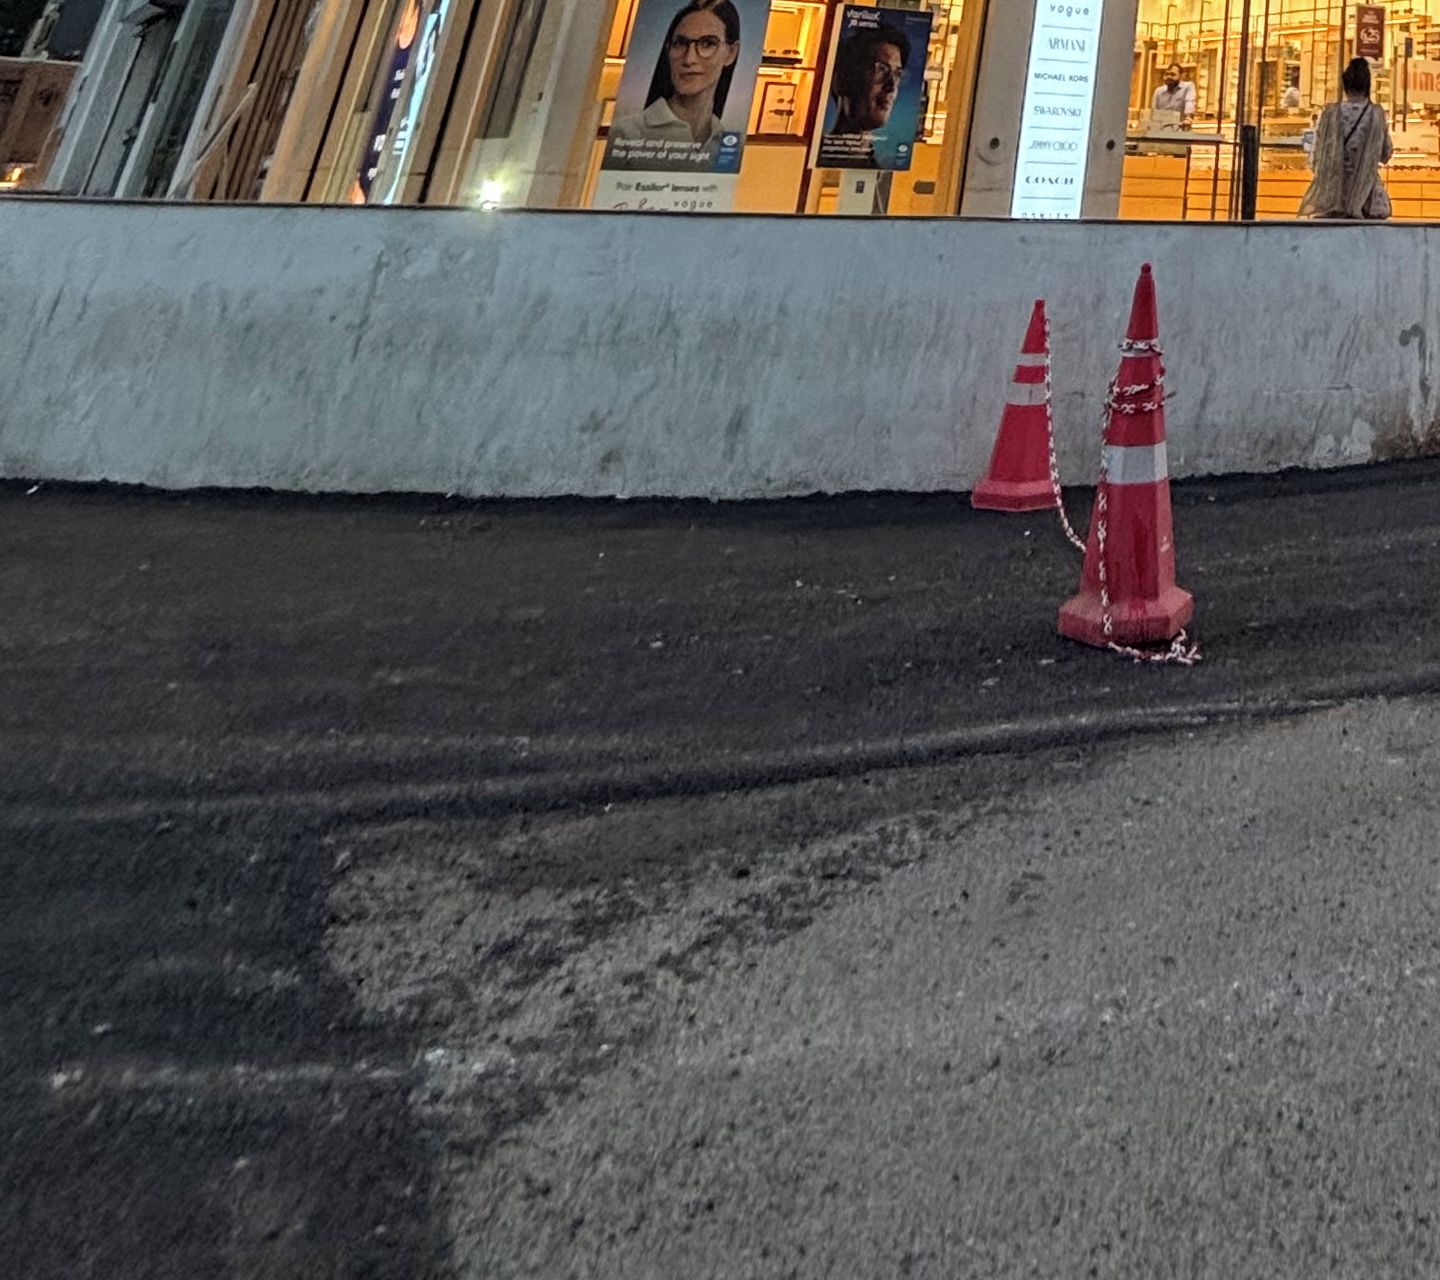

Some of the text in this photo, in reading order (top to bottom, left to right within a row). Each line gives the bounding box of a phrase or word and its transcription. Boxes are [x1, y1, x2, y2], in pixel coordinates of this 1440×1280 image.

[1049, 4, 1090, 17] vogue
[1048, 37, 1086, 53] ARMANI
[1034, 71, 1089, 84] MICHAEL KORS
[1033, 105, 1082, 118] SWAROVSKI
[613, 137, 702, 150] Reveal and preserve
[612, 148, 626, 158] the
[627, 150, 656, 160] power
[657, 150, 667, 159] of
[668, 152, 688, 161] your
[689, 152, 711, 163] sight
[1025, 175, 1075, 186] COACH
[671, 184, 700, 193] lenses
[673, 200, 713, 212] vogue
